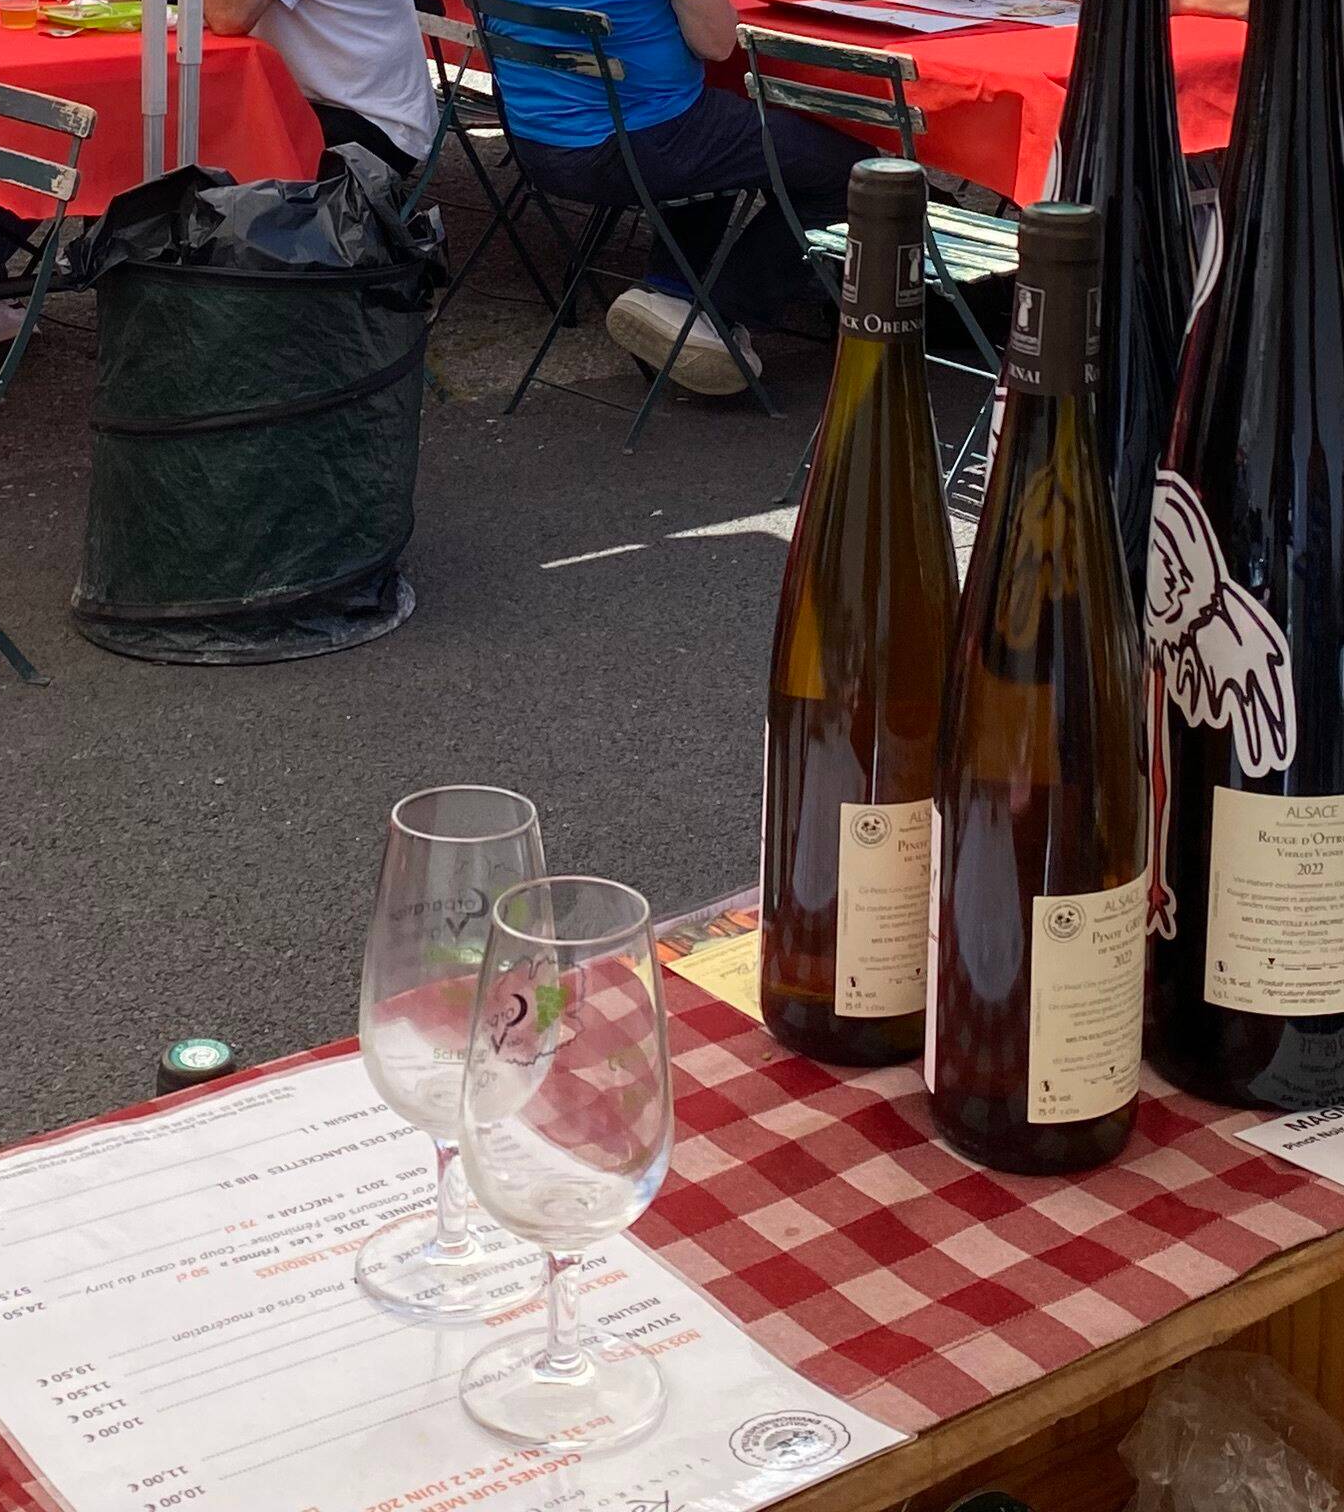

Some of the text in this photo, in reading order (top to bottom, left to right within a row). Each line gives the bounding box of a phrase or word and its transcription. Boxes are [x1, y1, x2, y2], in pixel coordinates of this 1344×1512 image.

[1286, 805, 1340, 819] ALSACE
[1296, 862, 1325, 876] 2022
[370, 1103, 388, 1114] DE
[323, 1110, 369, 1127] RAISIN
[359, 1135, 387, 1149] DES
[1283, 1136, 1319, 1152] Pinot
[267, 1143, 359, 1176] BLANCKETTES
[234, 1173, 259, 1185] BIB
[395, 1166, 428, 1182] GRIS
[355, 1179, 389, 1194] 2017
[411, 1183, 435, 1196] d'or
[278, 1195, 334, 1218] NECTAR
[348, 1192, 408, 1213] Concours
[238, 1219, 258, 1230] 75
[323, 1212, 346, 1223] des
[223, 1225, 236, 1235] cl
[250, 1219, 320, 1246] Féminalise
[176, 1218, 369, 1283] 2016 Les Frimas 50 cl
[199, 1244, 235, 1260] Coup
[179, 1257, 196, 1268] de
[254, 1251, 329, 1280] TARDIVES
[84, 1279, 114, 1295] Jury
[117, 1273, 136, 1285] du
[308, 1282, 344, 1298] Pinot
[277, 1293, 306, 1308] Gris
[2, 1302, 46, 1321] 24,50
[257, 1303, 274, 1315] de
[597, 1296, 661, 1326] RIESLING
[171, 1310, 254, 1342] macération
[50, 1363, 96, 1383] 19,50
[66, 1381, 112, 1401] 11,50
[81, 1398, 127, 1419] 11,50
[98, 1416, 144, 1438] 10,00
[142, 1466, 189, 1487] 11,00
[449, 1475, 465, 1486] 2
[464, 1468, 485, 1480] et
[466, 1452, 582, 1500] CAGNES SUR
[159, 1485, 206, 1508] 10,00
[404, 1480, 448, 1504] JUIN
